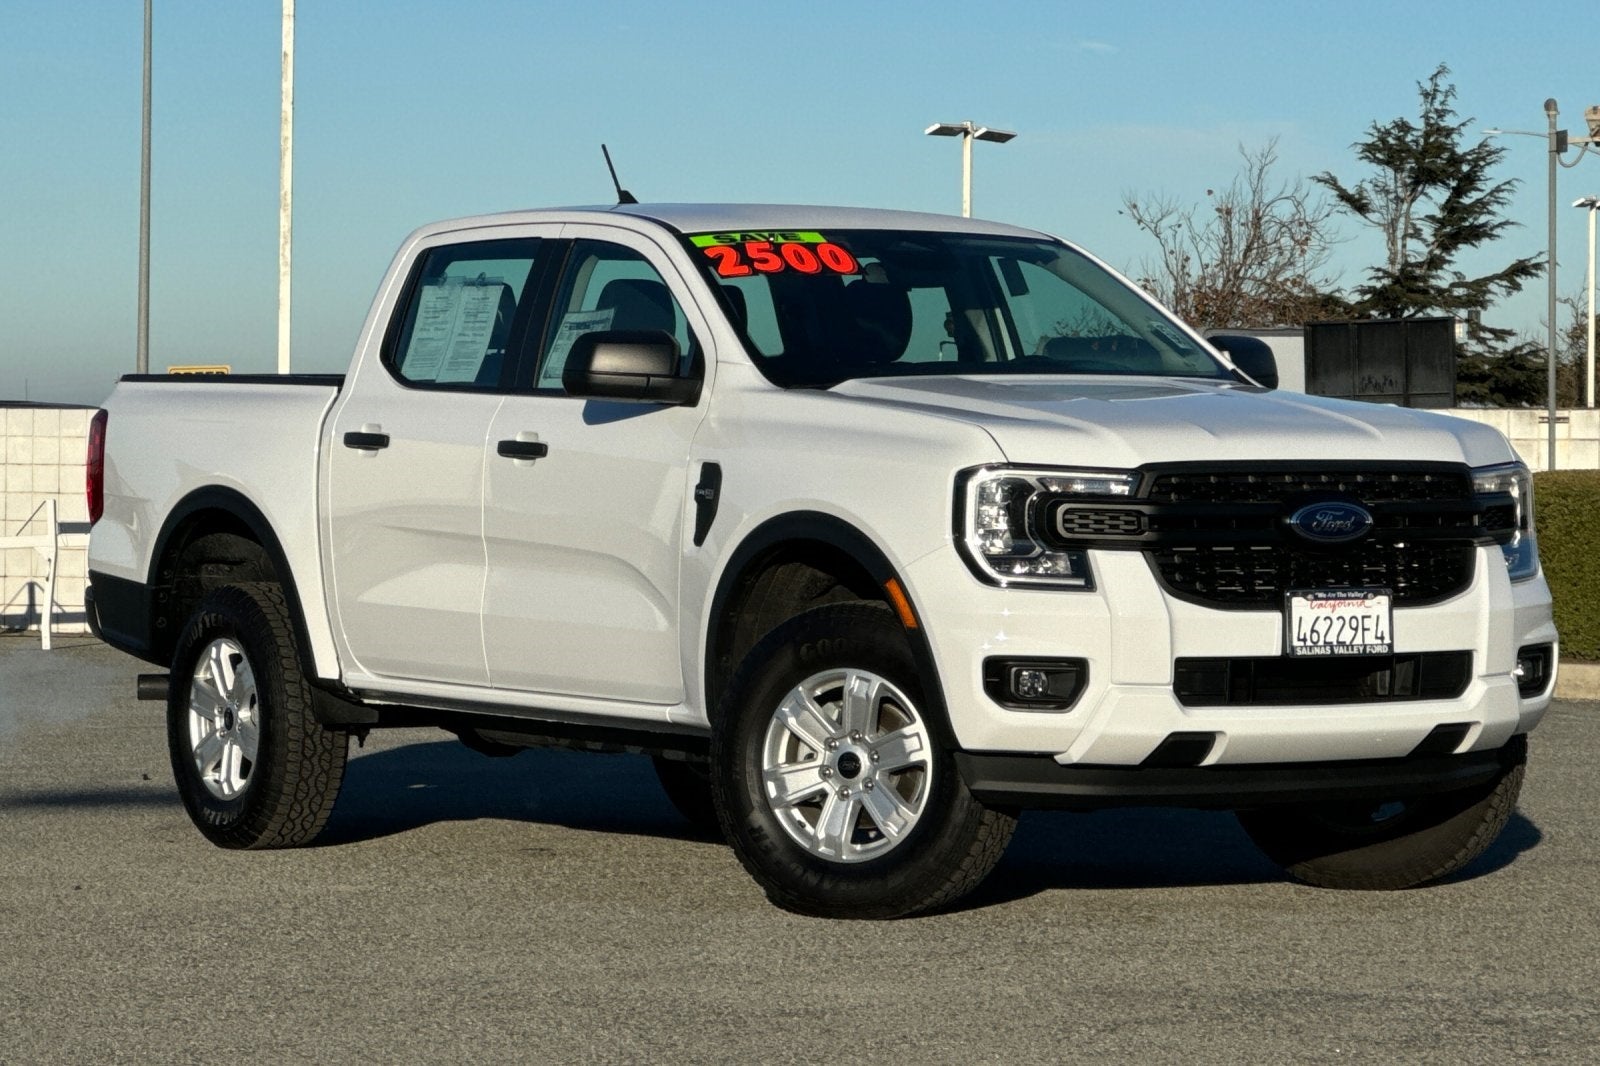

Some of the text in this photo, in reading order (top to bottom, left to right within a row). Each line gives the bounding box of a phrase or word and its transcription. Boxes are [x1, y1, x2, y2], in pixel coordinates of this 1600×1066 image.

[712, 232, 805, 244] SAVE
[703, 241, 858, 276] 2500
[1312, 510, 1356, 532] Ford
[1297, 615, 1385, 646] 46229F4
[1297, 644, 1389, 656] SALINAS VALLEY FORD
